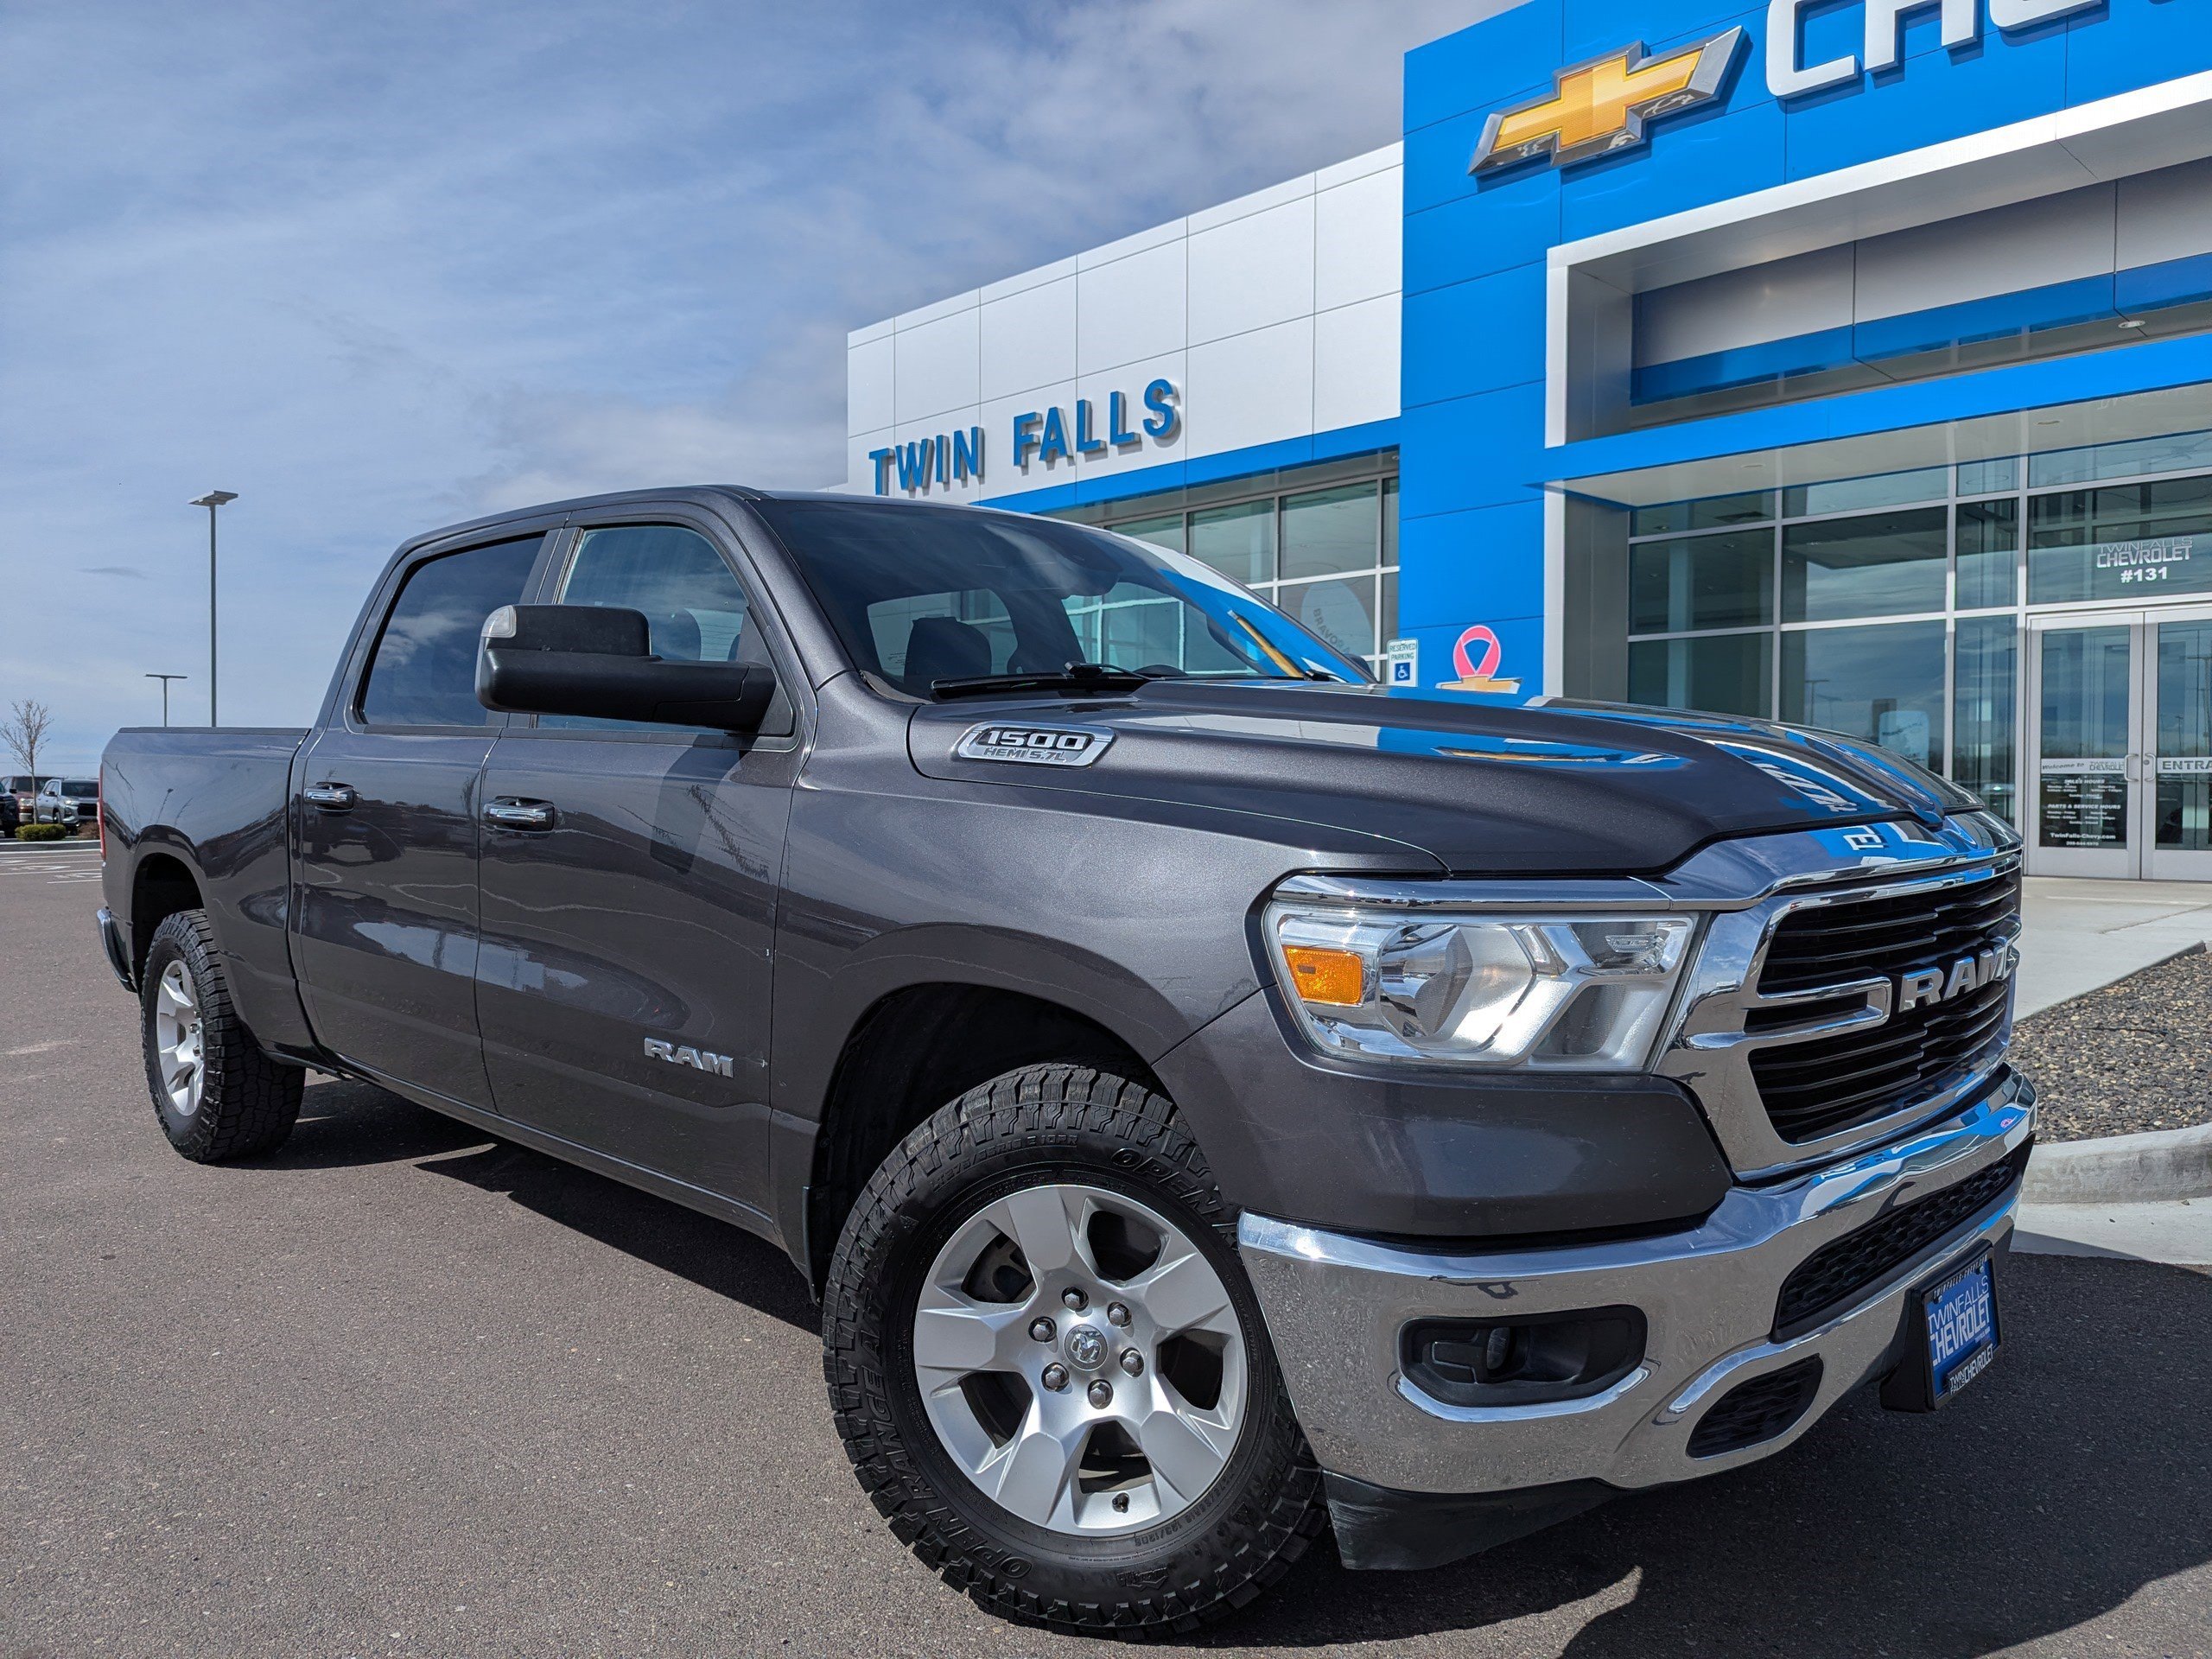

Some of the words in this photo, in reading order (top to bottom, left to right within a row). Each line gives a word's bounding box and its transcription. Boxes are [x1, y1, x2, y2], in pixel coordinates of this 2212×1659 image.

[868, 426, 984, 495] TWIN
[1013, 378, 1180, 467] FALLS
[2096, 545, 2193, 569] CHEVROLET
[2120, 567, 2168, 583] #131
[1389, 643, 1415, 652] RESERVED
[983, 747, 1025, 758] HEMI
[987, 730, 1088, 750] 1500
[1898, 938, 2007, 1013] RAM
[644, 1037, 734, 1078] RAM
[1928, 1275, 1989, 1333] TWINFALLS
[1965, 1343, 1993, 1383] CHEVROLET
